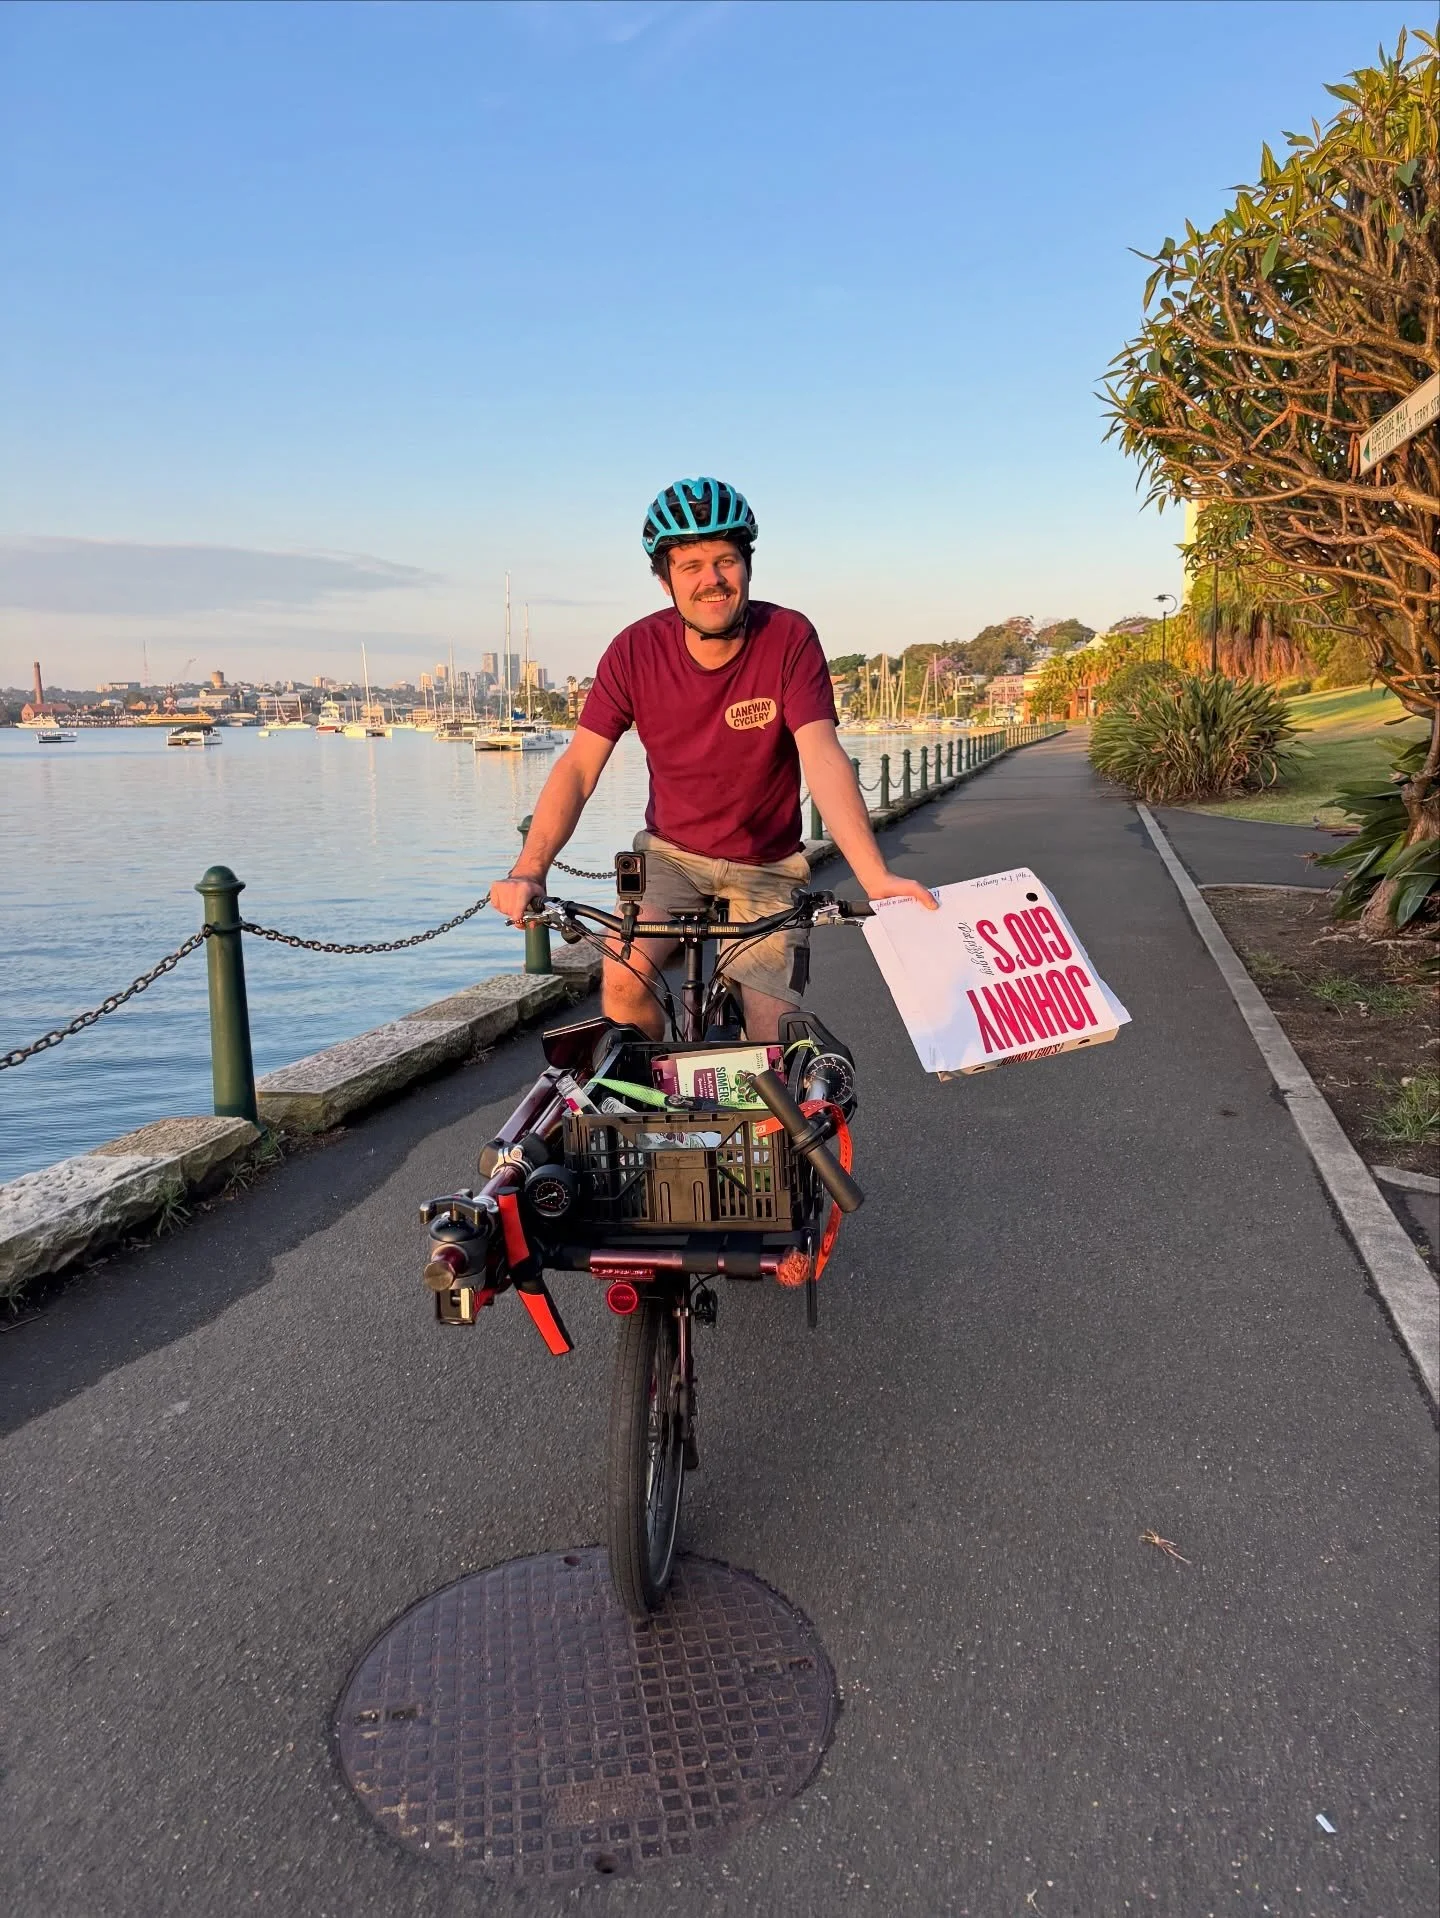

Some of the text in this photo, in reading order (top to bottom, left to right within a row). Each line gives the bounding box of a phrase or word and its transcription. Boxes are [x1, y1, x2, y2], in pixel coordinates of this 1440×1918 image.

[730, 700, 772, 719] LANEWAY
[733, 711, 770, 728] CYCLERY
[976, 905, 1073, 974] GIO'S
[966, 965, 1099, 1054] JOHNNY
[997, 1049, 1036, 1068] JOHNNY
